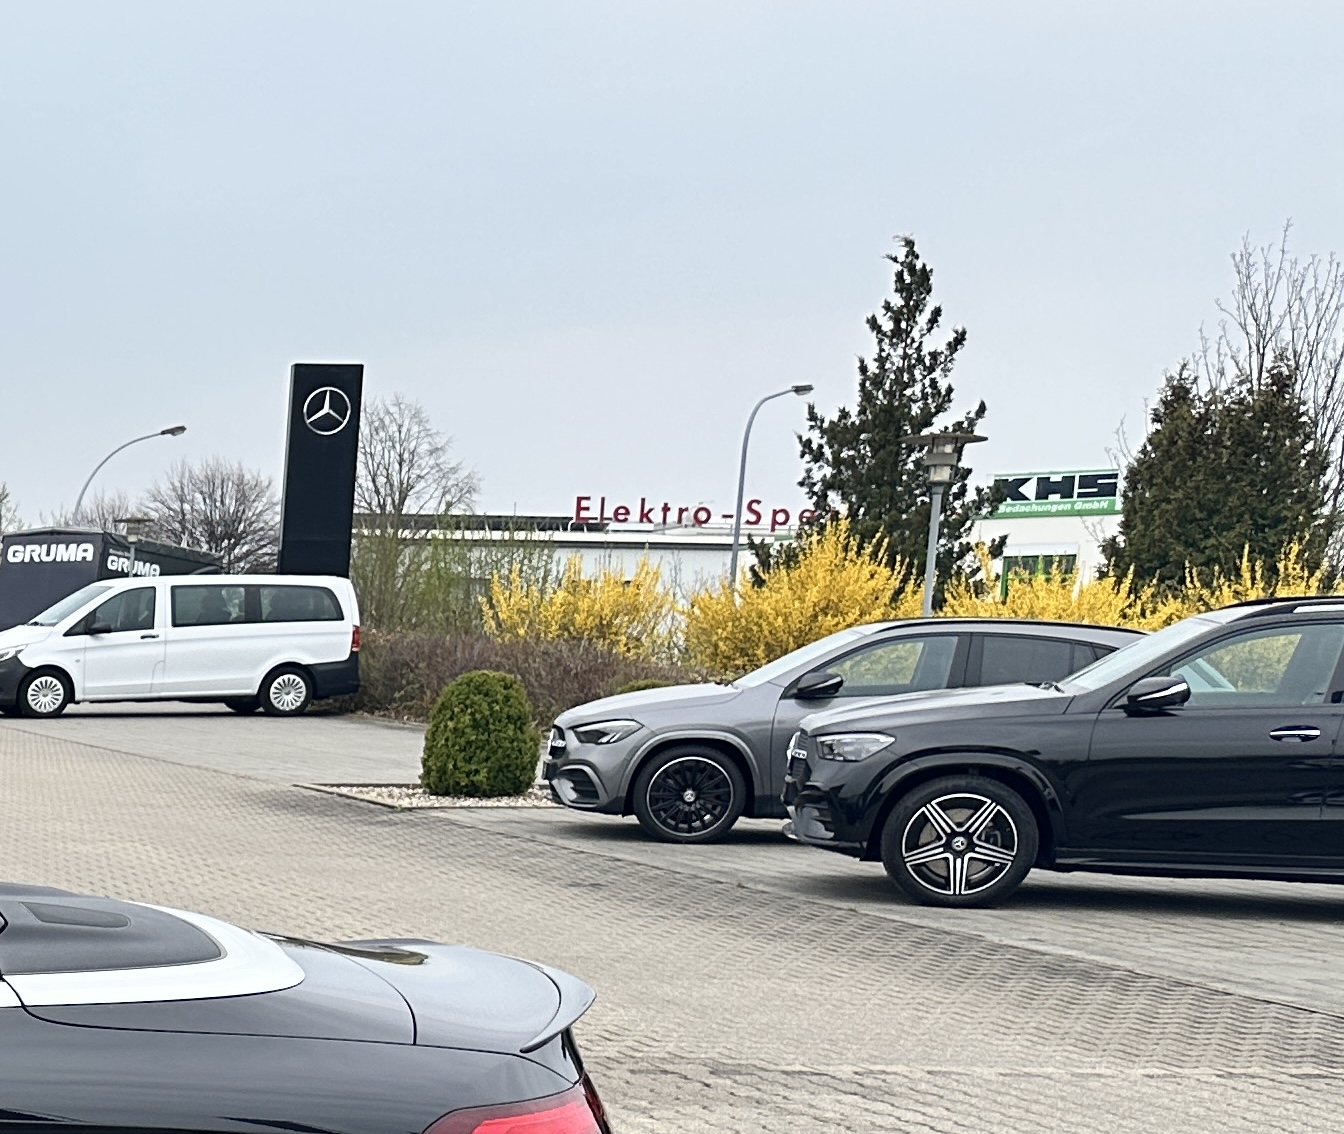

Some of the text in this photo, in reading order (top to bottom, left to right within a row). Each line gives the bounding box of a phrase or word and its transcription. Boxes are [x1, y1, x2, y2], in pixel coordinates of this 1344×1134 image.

[994, 473, 1118, 501] KHS
[997, 499, 1109, 514] Bedachungen GmbH
[7, 543, 94, 562] GRUMA
